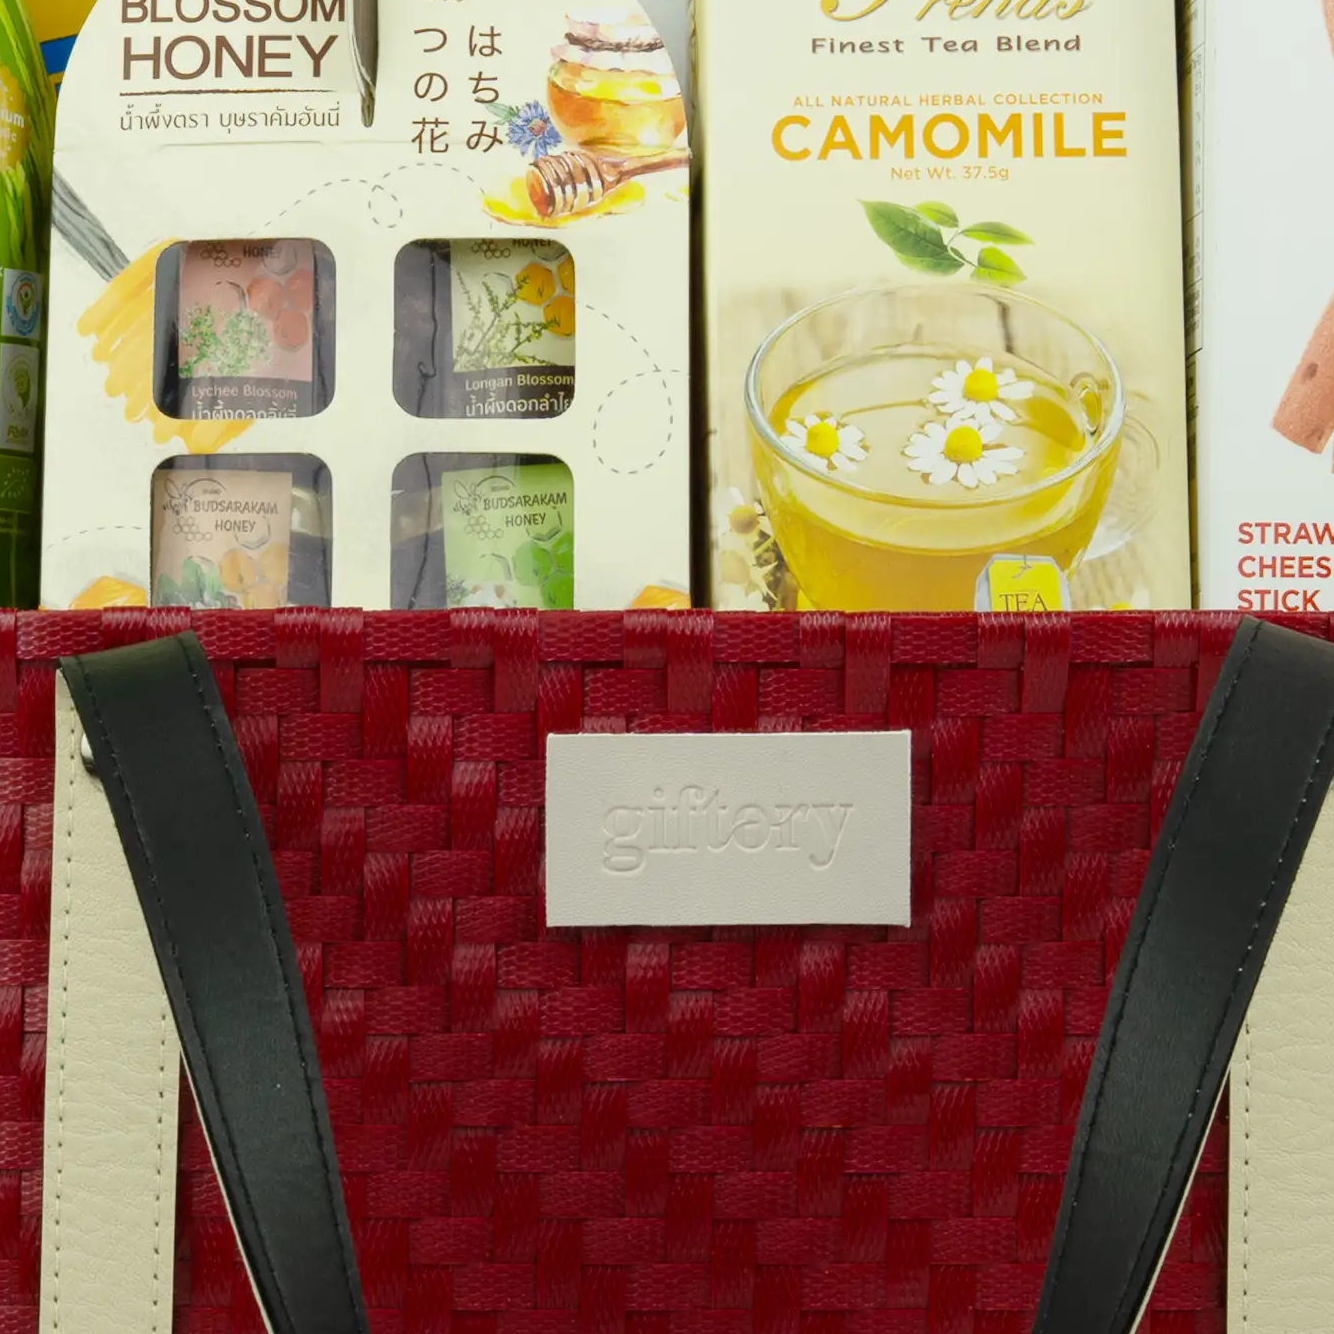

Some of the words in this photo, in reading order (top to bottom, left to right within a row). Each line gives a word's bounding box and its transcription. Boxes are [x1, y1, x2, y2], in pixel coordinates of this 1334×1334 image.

[811, 37, 905, 55] Finest
[921, 36, 979, 53] Tea
[996, 34, 1082, 53] Blend
[123, 35, 339, 80] HONEY
[793, 95, 824, 108] ALL
[831, 94, 913, 108] NATURAL
[919, 93, 986, 107] HERBAL
[993, 92, 1104, 106] COLLECTION
[120, 103, 209, 131] น้ำผึ้งตรา
[219, 101, 340, 134] บุษราคัมฮันนี่
[771, 111, 1128, 162] CAMOMILE
[891, 166, 921, 181] Net
[925, 166, 956, 181] Wt.
[962, 166, 1010, 182] 37.5g
[465, 376, 513, 391] Longan
[517, 373, 574, 386] Blossom
[192, 385, 239, 400] Lychee
[243, 384, 298, 400] Blossom
[193, 499, 279, 516] BUDSARAKAM
[483, 491, 568, 511] BUDSARAKAM
[215, 519, 256, 533] HONEY
[505, 511, 547, 528] HONEY
[999, 592, 1048, 612] TEA
[1237, 589, 1322, 612] STICK
